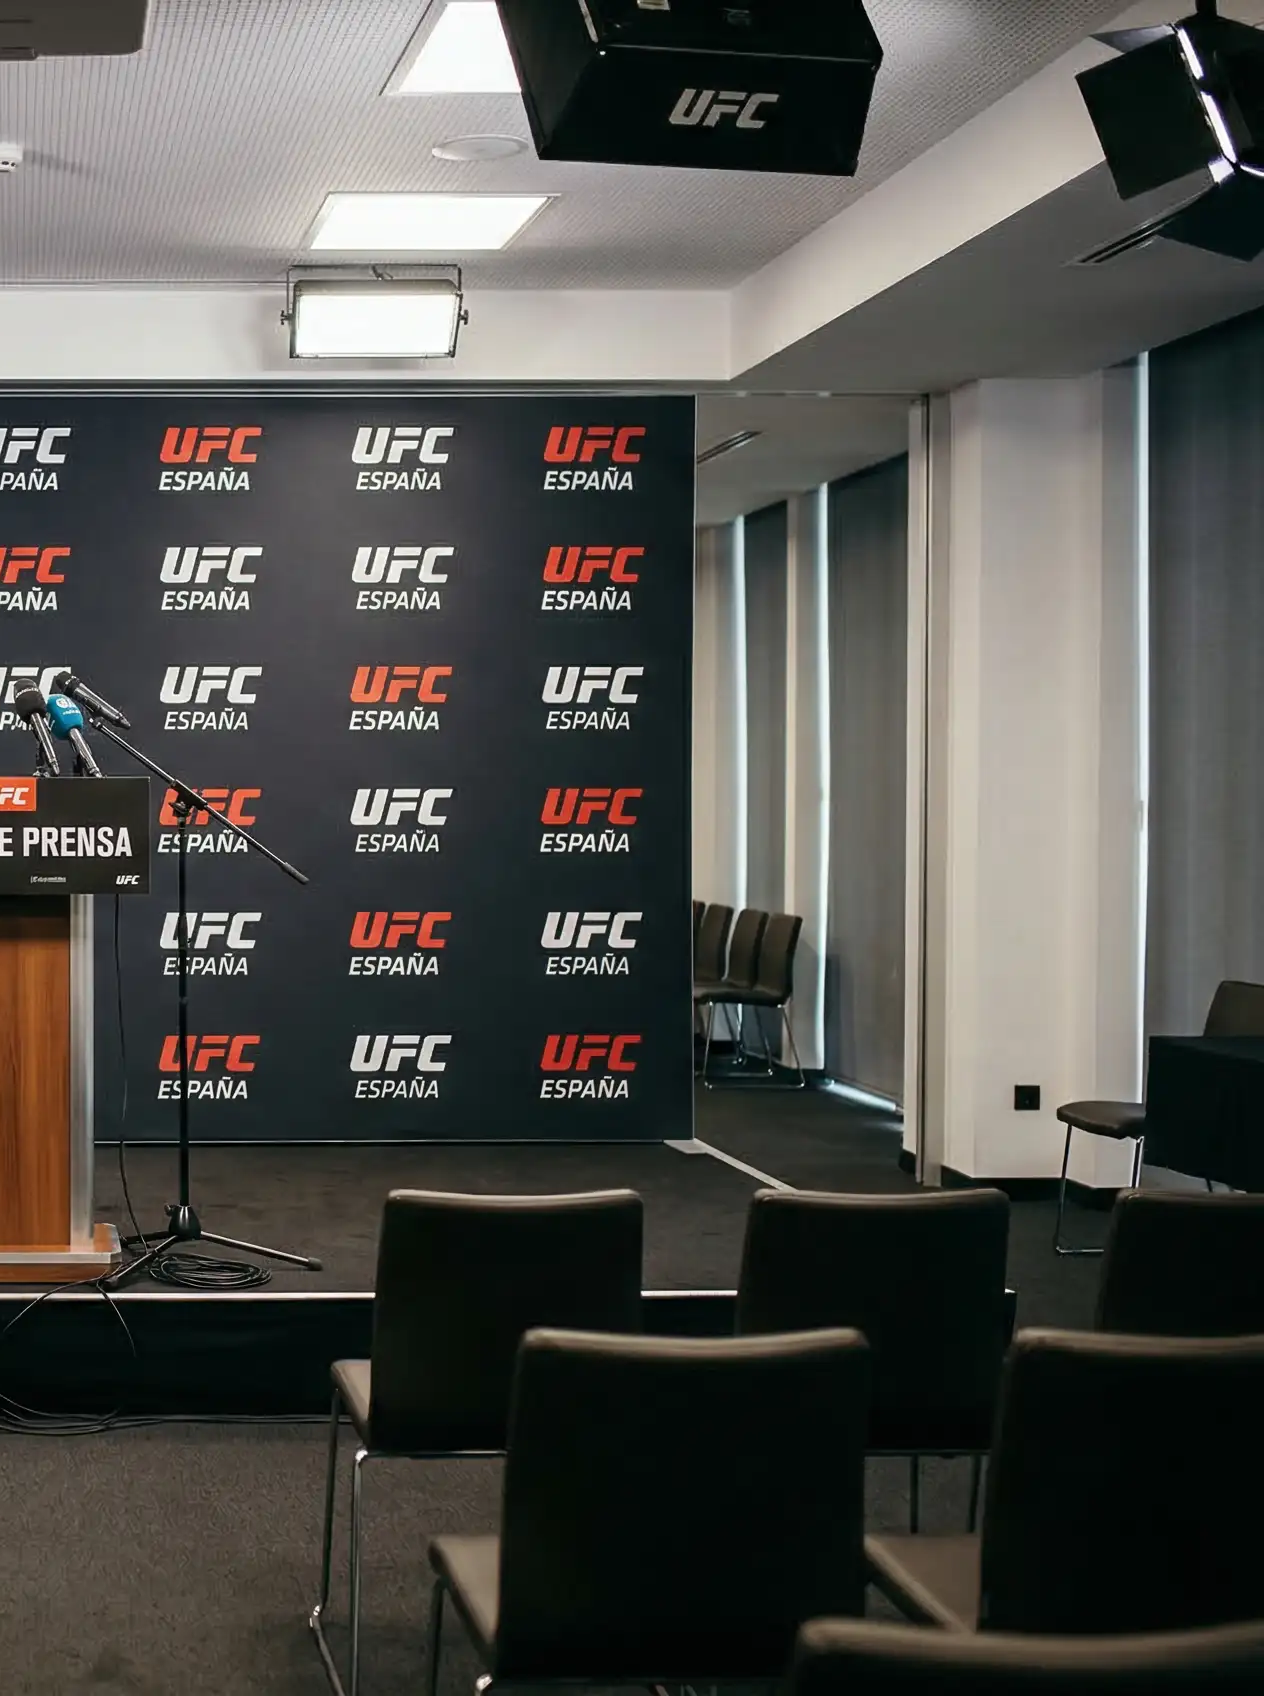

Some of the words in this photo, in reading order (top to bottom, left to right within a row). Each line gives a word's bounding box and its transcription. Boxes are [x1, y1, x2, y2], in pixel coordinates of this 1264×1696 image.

[669, 88, 779, 129] UFC
[159, 426, 262, 464] UFC
[351, 426, 455, 465] UFC
[543, 426, 645, 463] UFC
[158, 466, 250, 492] ESPAÑA
[355, 467, 441, 491] ESPAÑA
[543, 466, 633, 491] ESPAÑA
[159, 546, 264, 584] UFC
[351, 546, 455, 584] UFC
[542, 546, 645, 583] UFC
[160, 586, 250, 611] ESPAÑA
[355, 586, 441, 611] ESPAÑA
[541, 586, 632, 611] ESPAÑA
[159, 666, 263, 704] UFC
[349, 665, 453, 704] UFC
[541, 666, 644, 704] UFC
[163, 707, 249, 731] ESPAÑA
[348, 706, 440, 731] ESPAÑA
[545, 707, 630, 730] ESPAÑA
[349, 788, 454, 826] UFC
[540, 788, 643, 825] UFC
[22, 826, 133, 857] PRENSA
[354, 829, 440, 853] ESPAÑA
[539, 829, 630, 853] ESPAÑA
[115, 874, 140, 885] UFC
[160, 912, 262, 949] UFC
[349, 911, 452, 949] UFC
[540, 911, 643, 949] UFC
[348, 952, 439, 976] ESPAÑA
[545, 952, 629, 975] ESPAÑA
[159, 1035, 261, 1072] UFC
[349, 1034, 452, 1072] UFC
[540, 1035, 641, 1071] UFC
[157, 1076, 248, 1099] ESPAÑA
[354, 1076, 439, 1099] ESPAÑA
[539, 1075, 629, 1099] ESPAÑA
